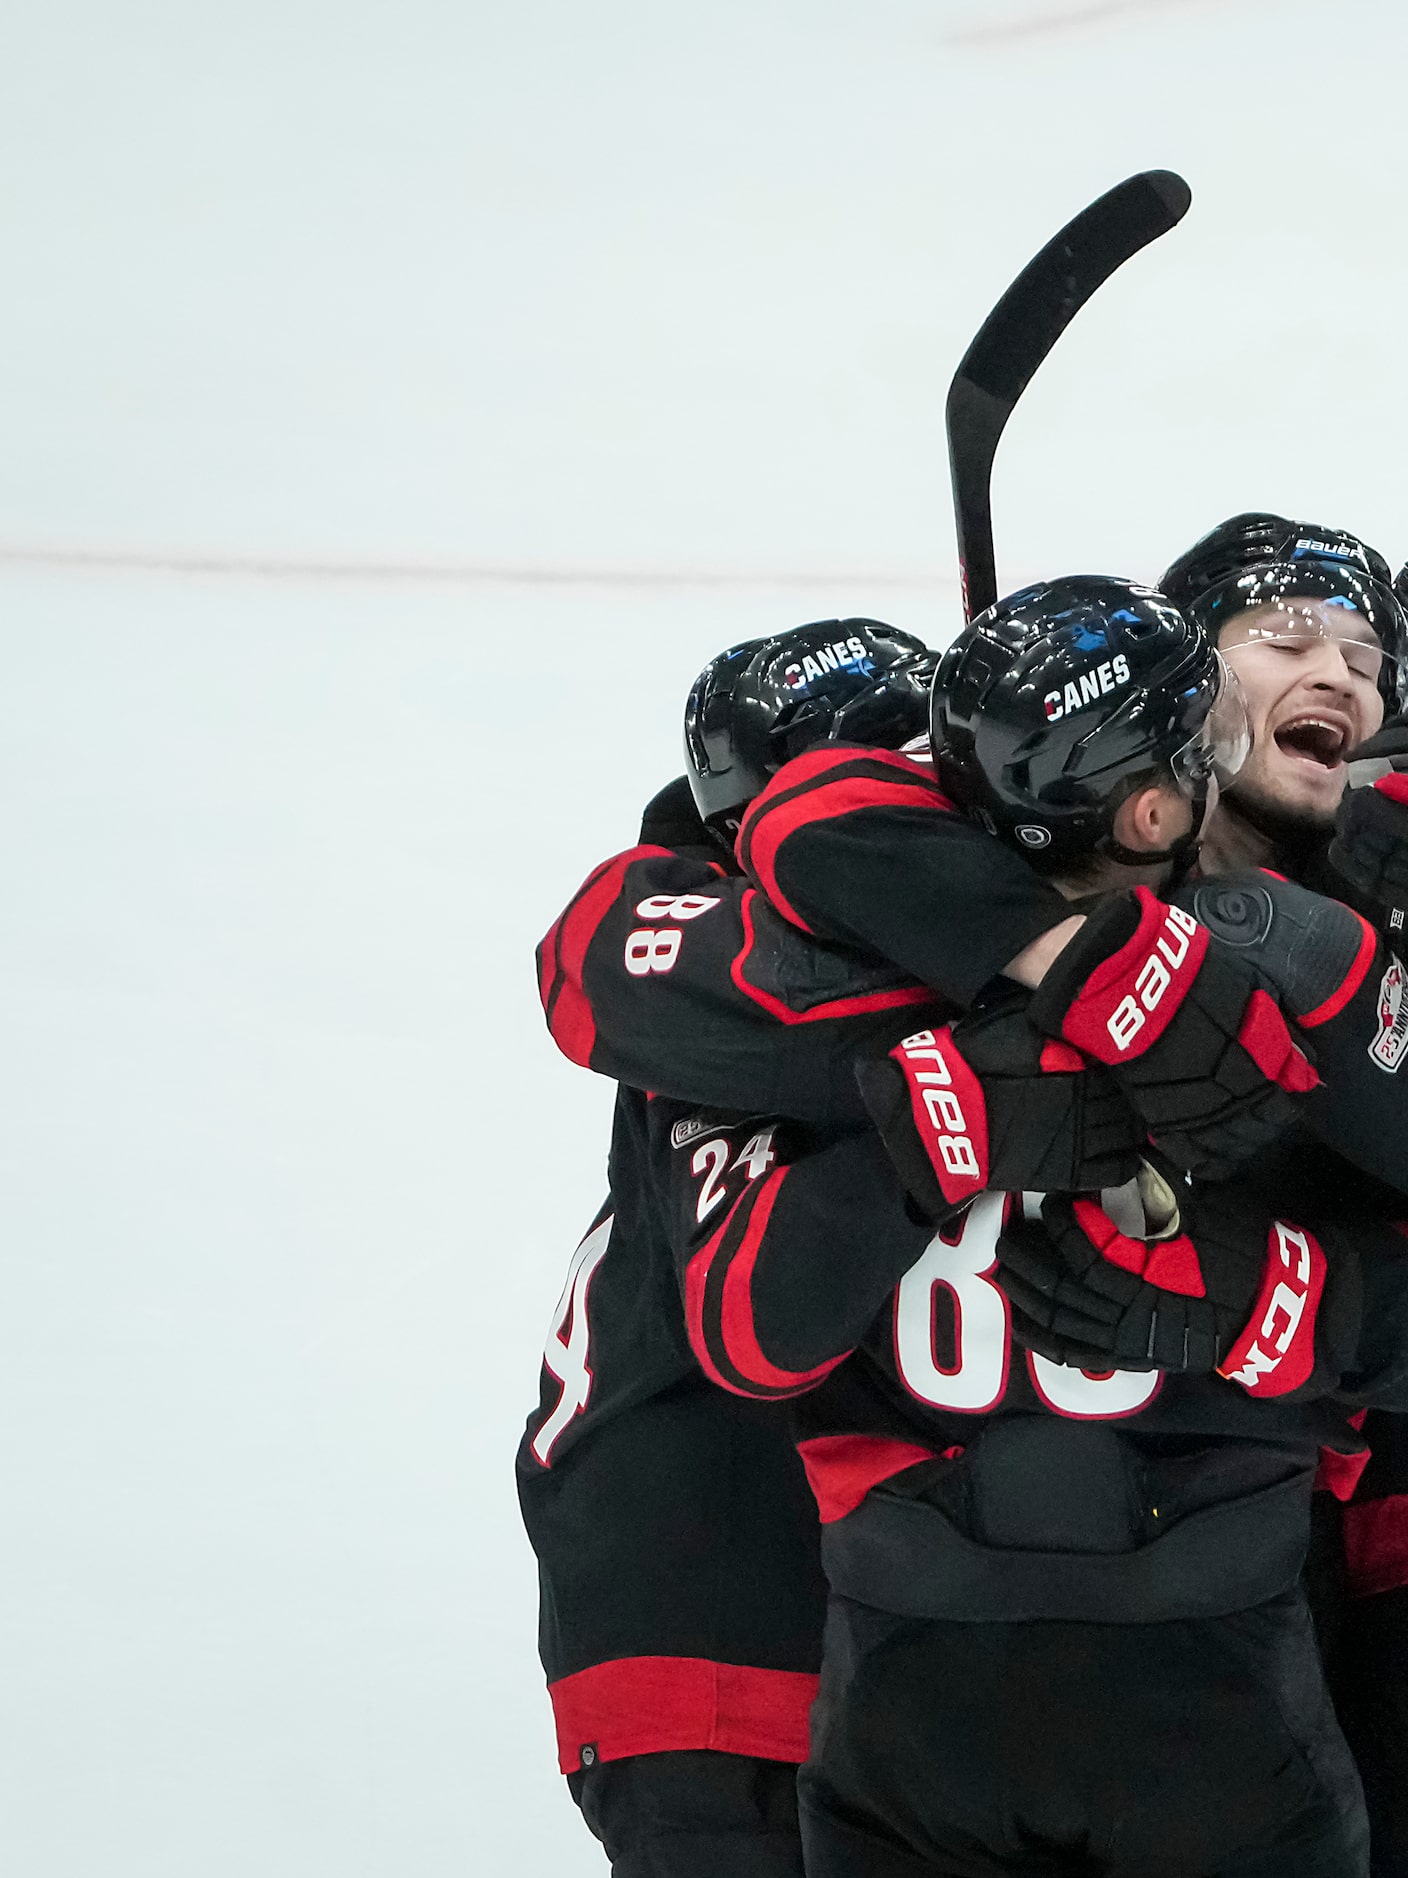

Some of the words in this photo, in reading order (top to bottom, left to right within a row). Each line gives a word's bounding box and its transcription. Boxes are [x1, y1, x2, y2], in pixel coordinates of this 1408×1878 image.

[784, 636, 867, 690] CANES
[1044, 653, 1130, 722] CANES
[624, 893, 722, 977] 88
[690, 1125, 776, 1223] 24
[1229, 1220, 1311, 1387] CCM
